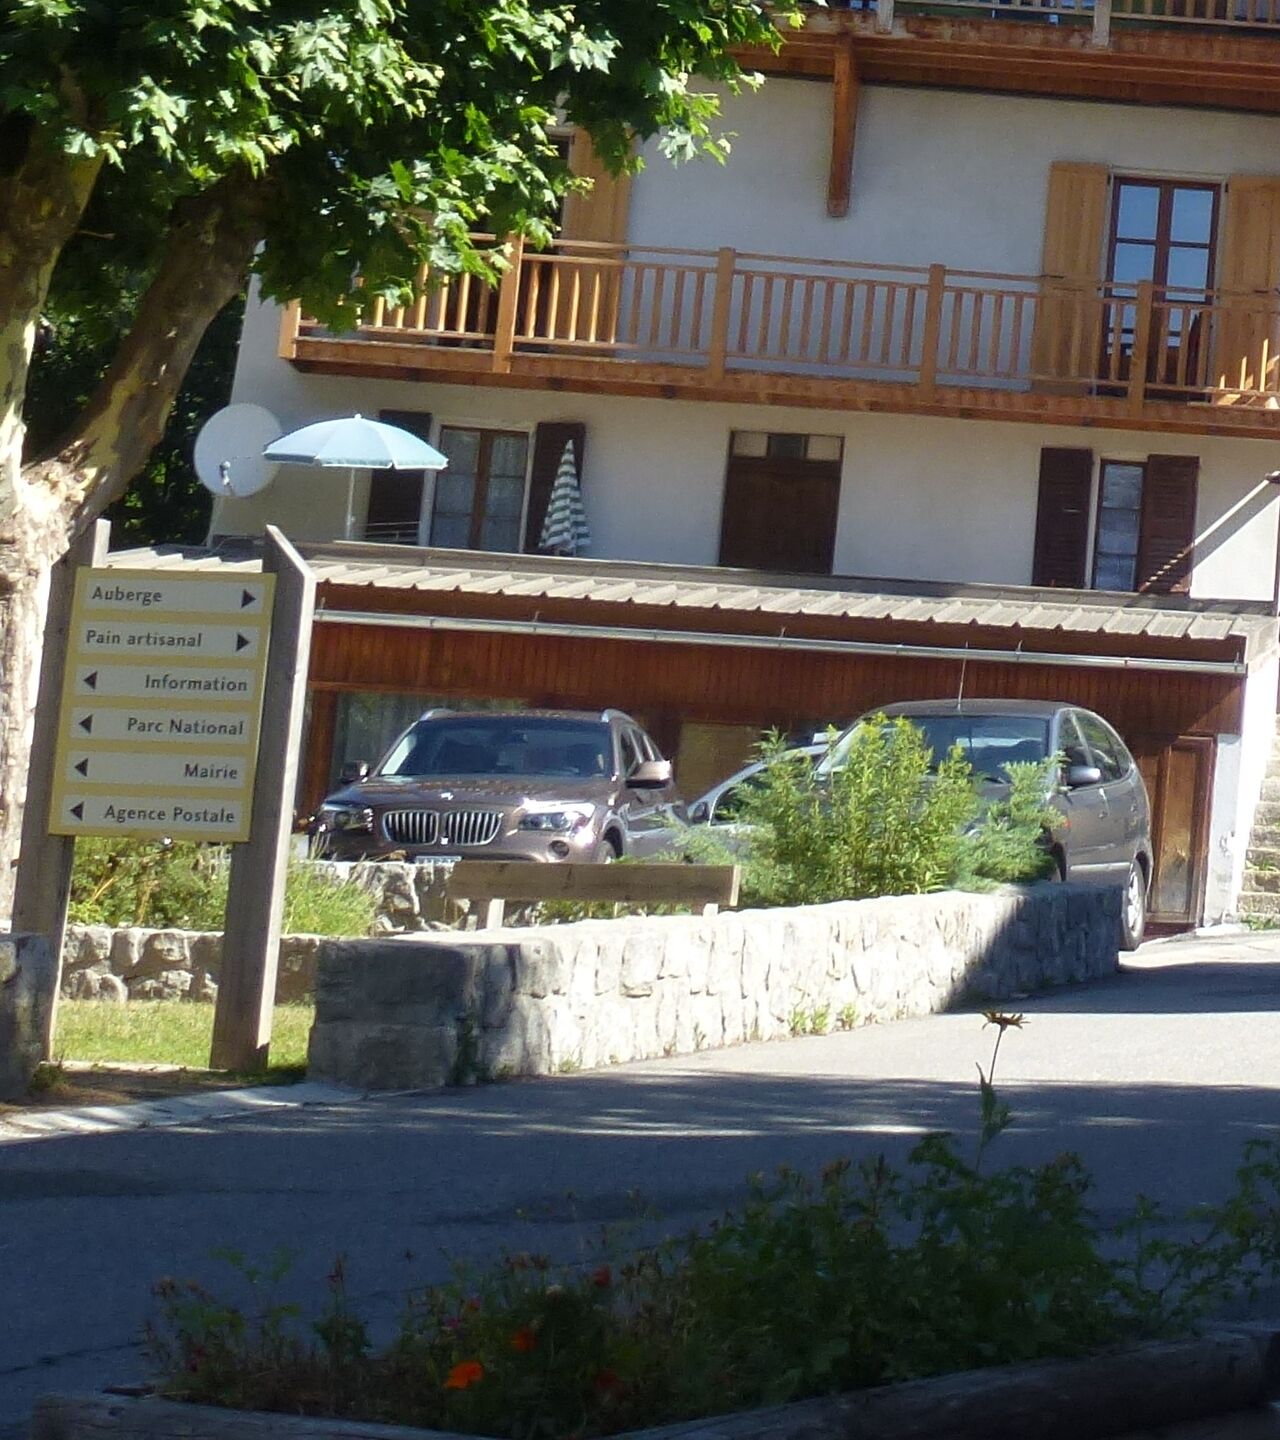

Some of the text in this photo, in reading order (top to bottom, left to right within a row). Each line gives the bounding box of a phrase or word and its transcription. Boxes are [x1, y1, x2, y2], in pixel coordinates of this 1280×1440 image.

[91, 586, 163, 606] Auberge
[86, 629, 203, 648] Pain artisanal
[144, 673, 248, 692] Information
[127, 716, 245, 736] Parc National
[183, 763, 238, 780] Mairie
[104, 804, 236, 824] Agence Postale
